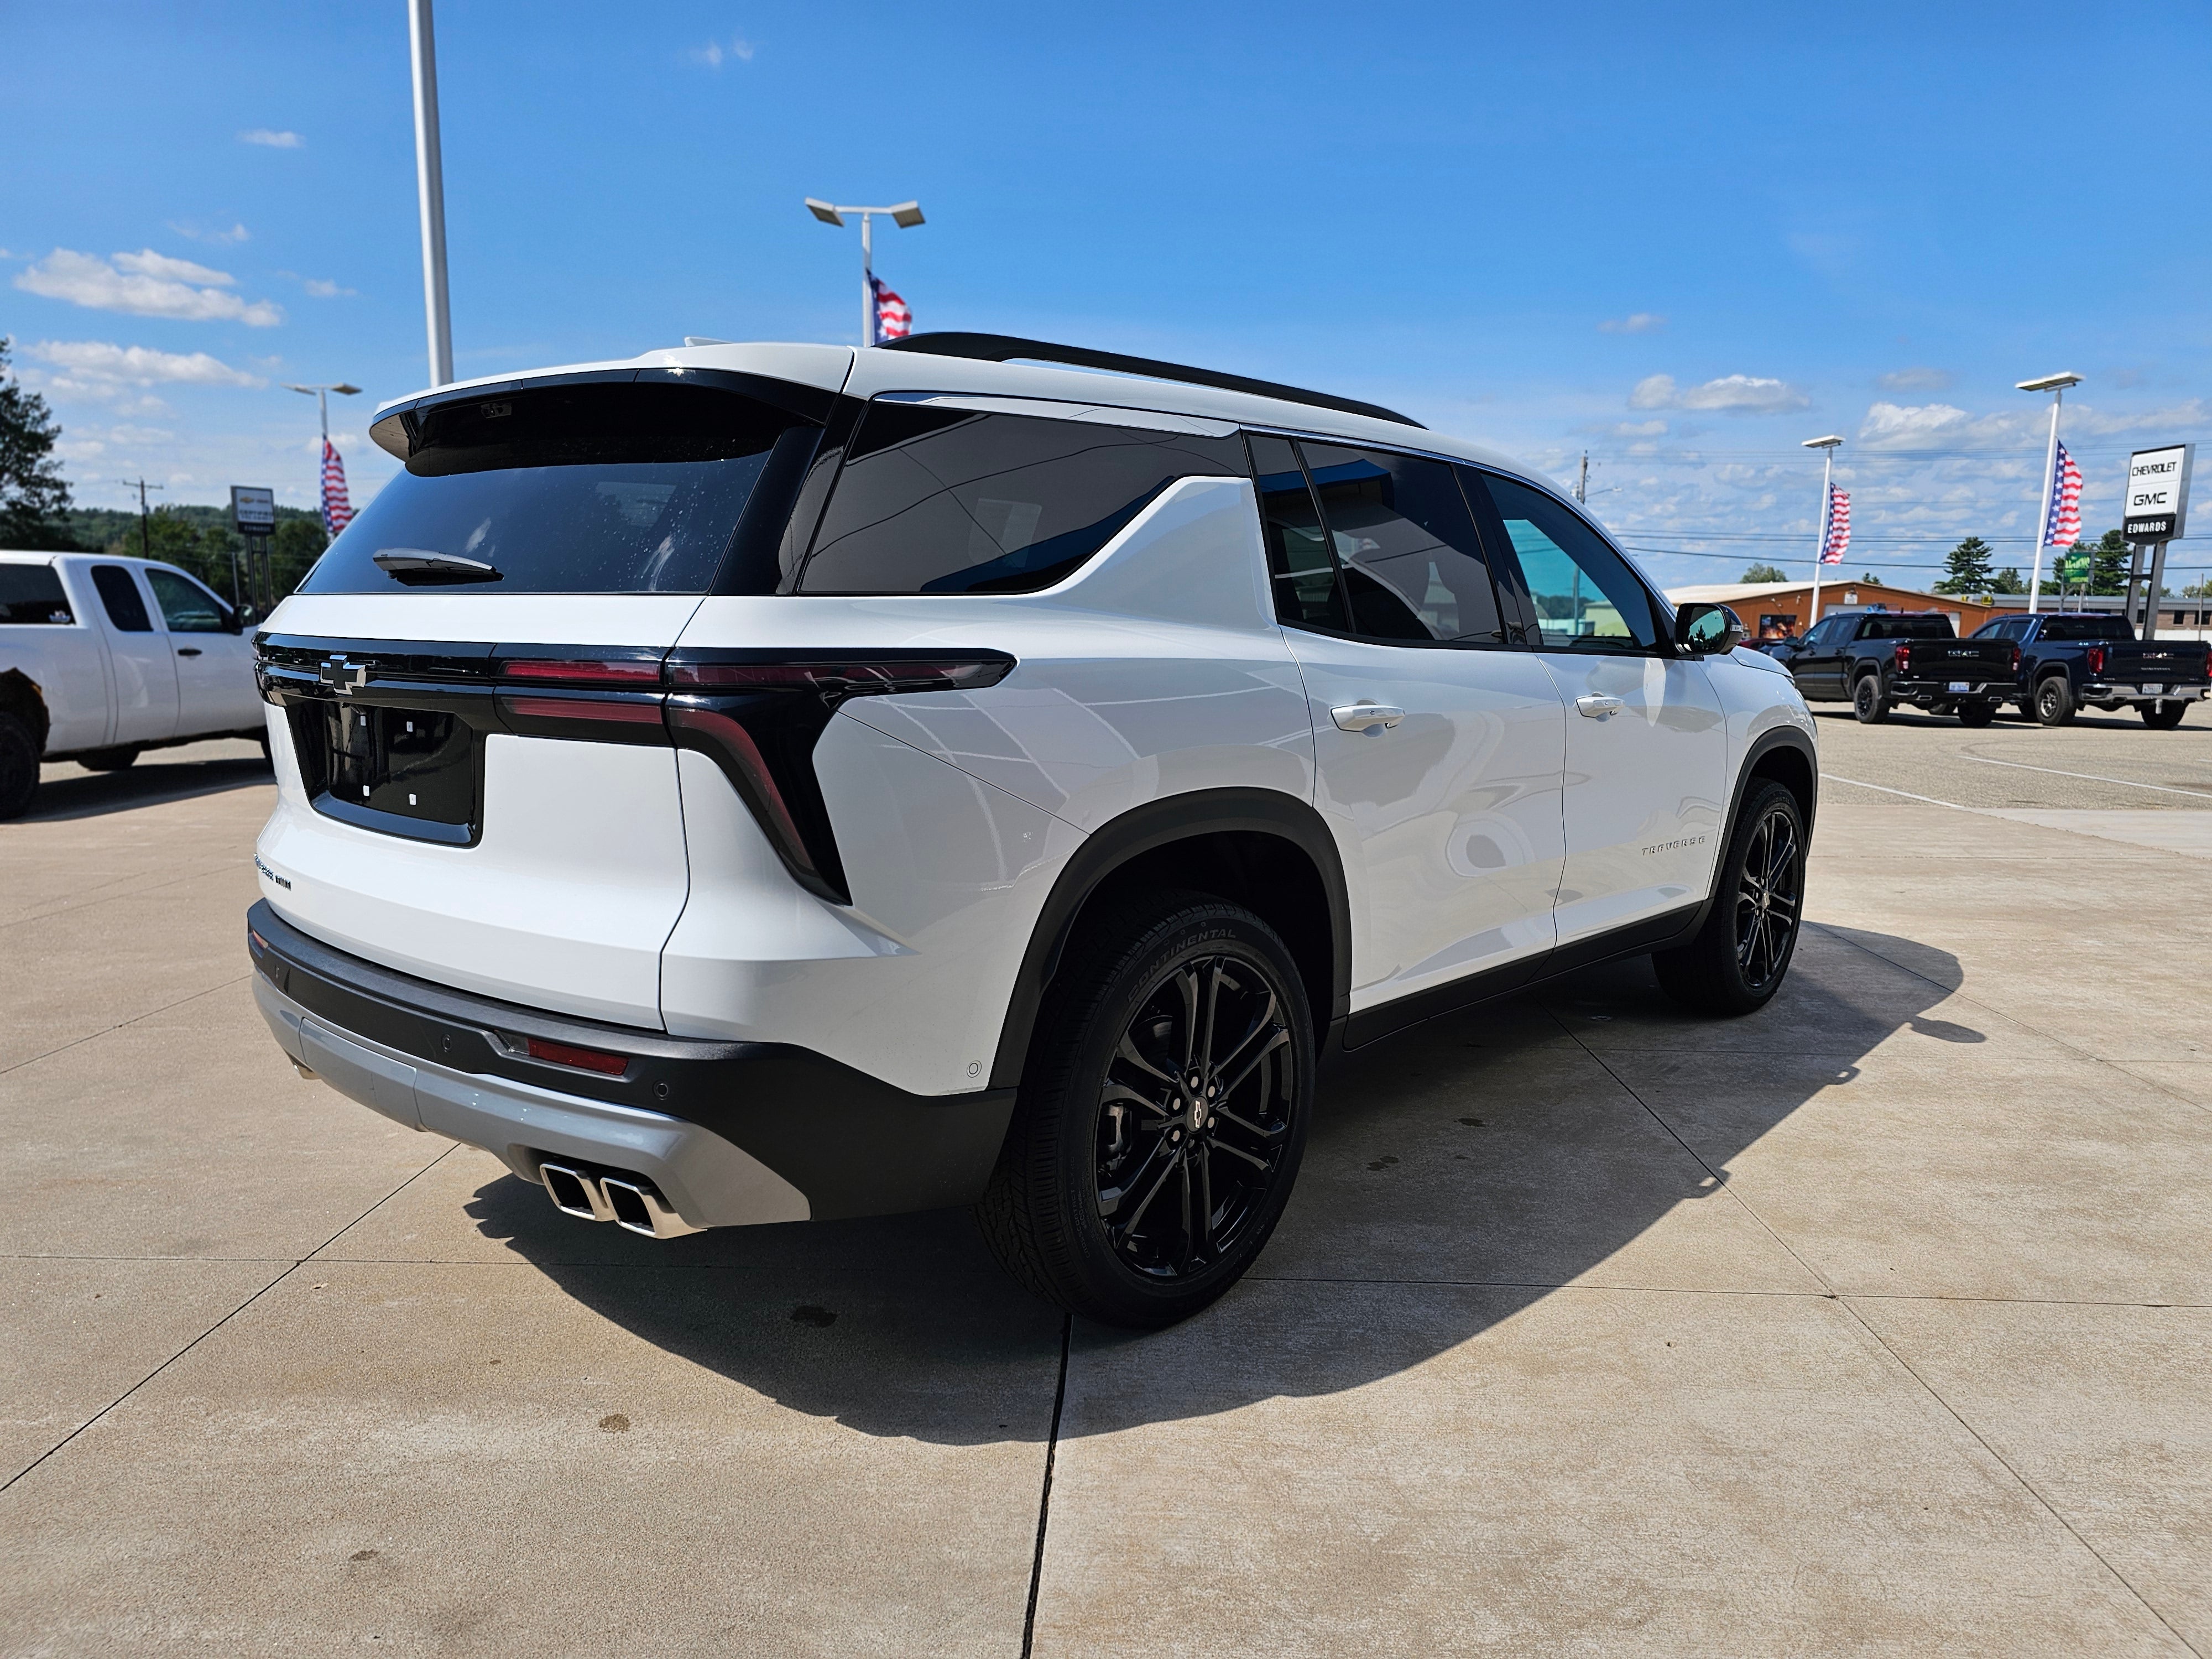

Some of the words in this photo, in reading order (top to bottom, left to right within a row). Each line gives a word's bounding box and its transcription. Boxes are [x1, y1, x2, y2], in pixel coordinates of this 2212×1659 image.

[2132, 461, 2177, 476] CHEVROLET
[2133, 492, 2167, 506] GMC
[2127, 521, 2167, 534] EDWARDS
[1642, 836, 1705, 855] TRAVERSE
[1128, 928, 1237, 1004] CONTINENTAL
